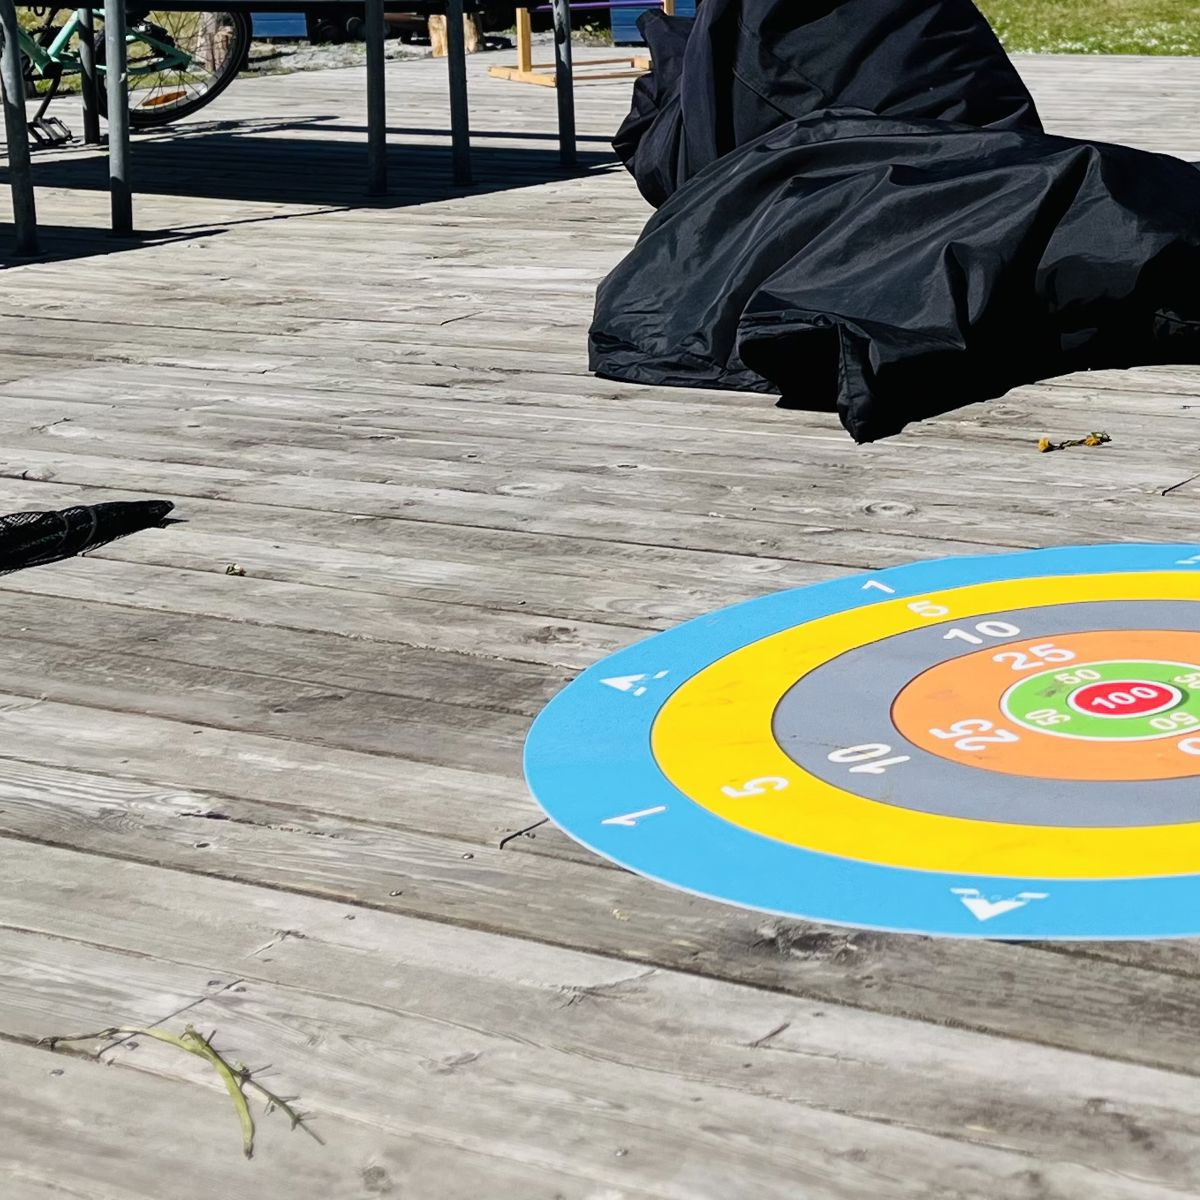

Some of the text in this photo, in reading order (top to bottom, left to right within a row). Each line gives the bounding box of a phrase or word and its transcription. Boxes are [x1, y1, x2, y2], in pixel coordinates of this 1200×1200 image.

[907, 600, 949, 618] 5
[942, 619, 1021, 645] 10
[991, 642, 1077, 672] 25
[1054, 669, 1102, 686] 50
[1091, 686, 1159, 710] 100
[1025, 708, 1072, 727] 50
[1149, 711, 1200, 731] 50
[928, 717, 1020, 751] 25
[826, 742, 911, 775] 10
[720, 775, 790, 799] 5
